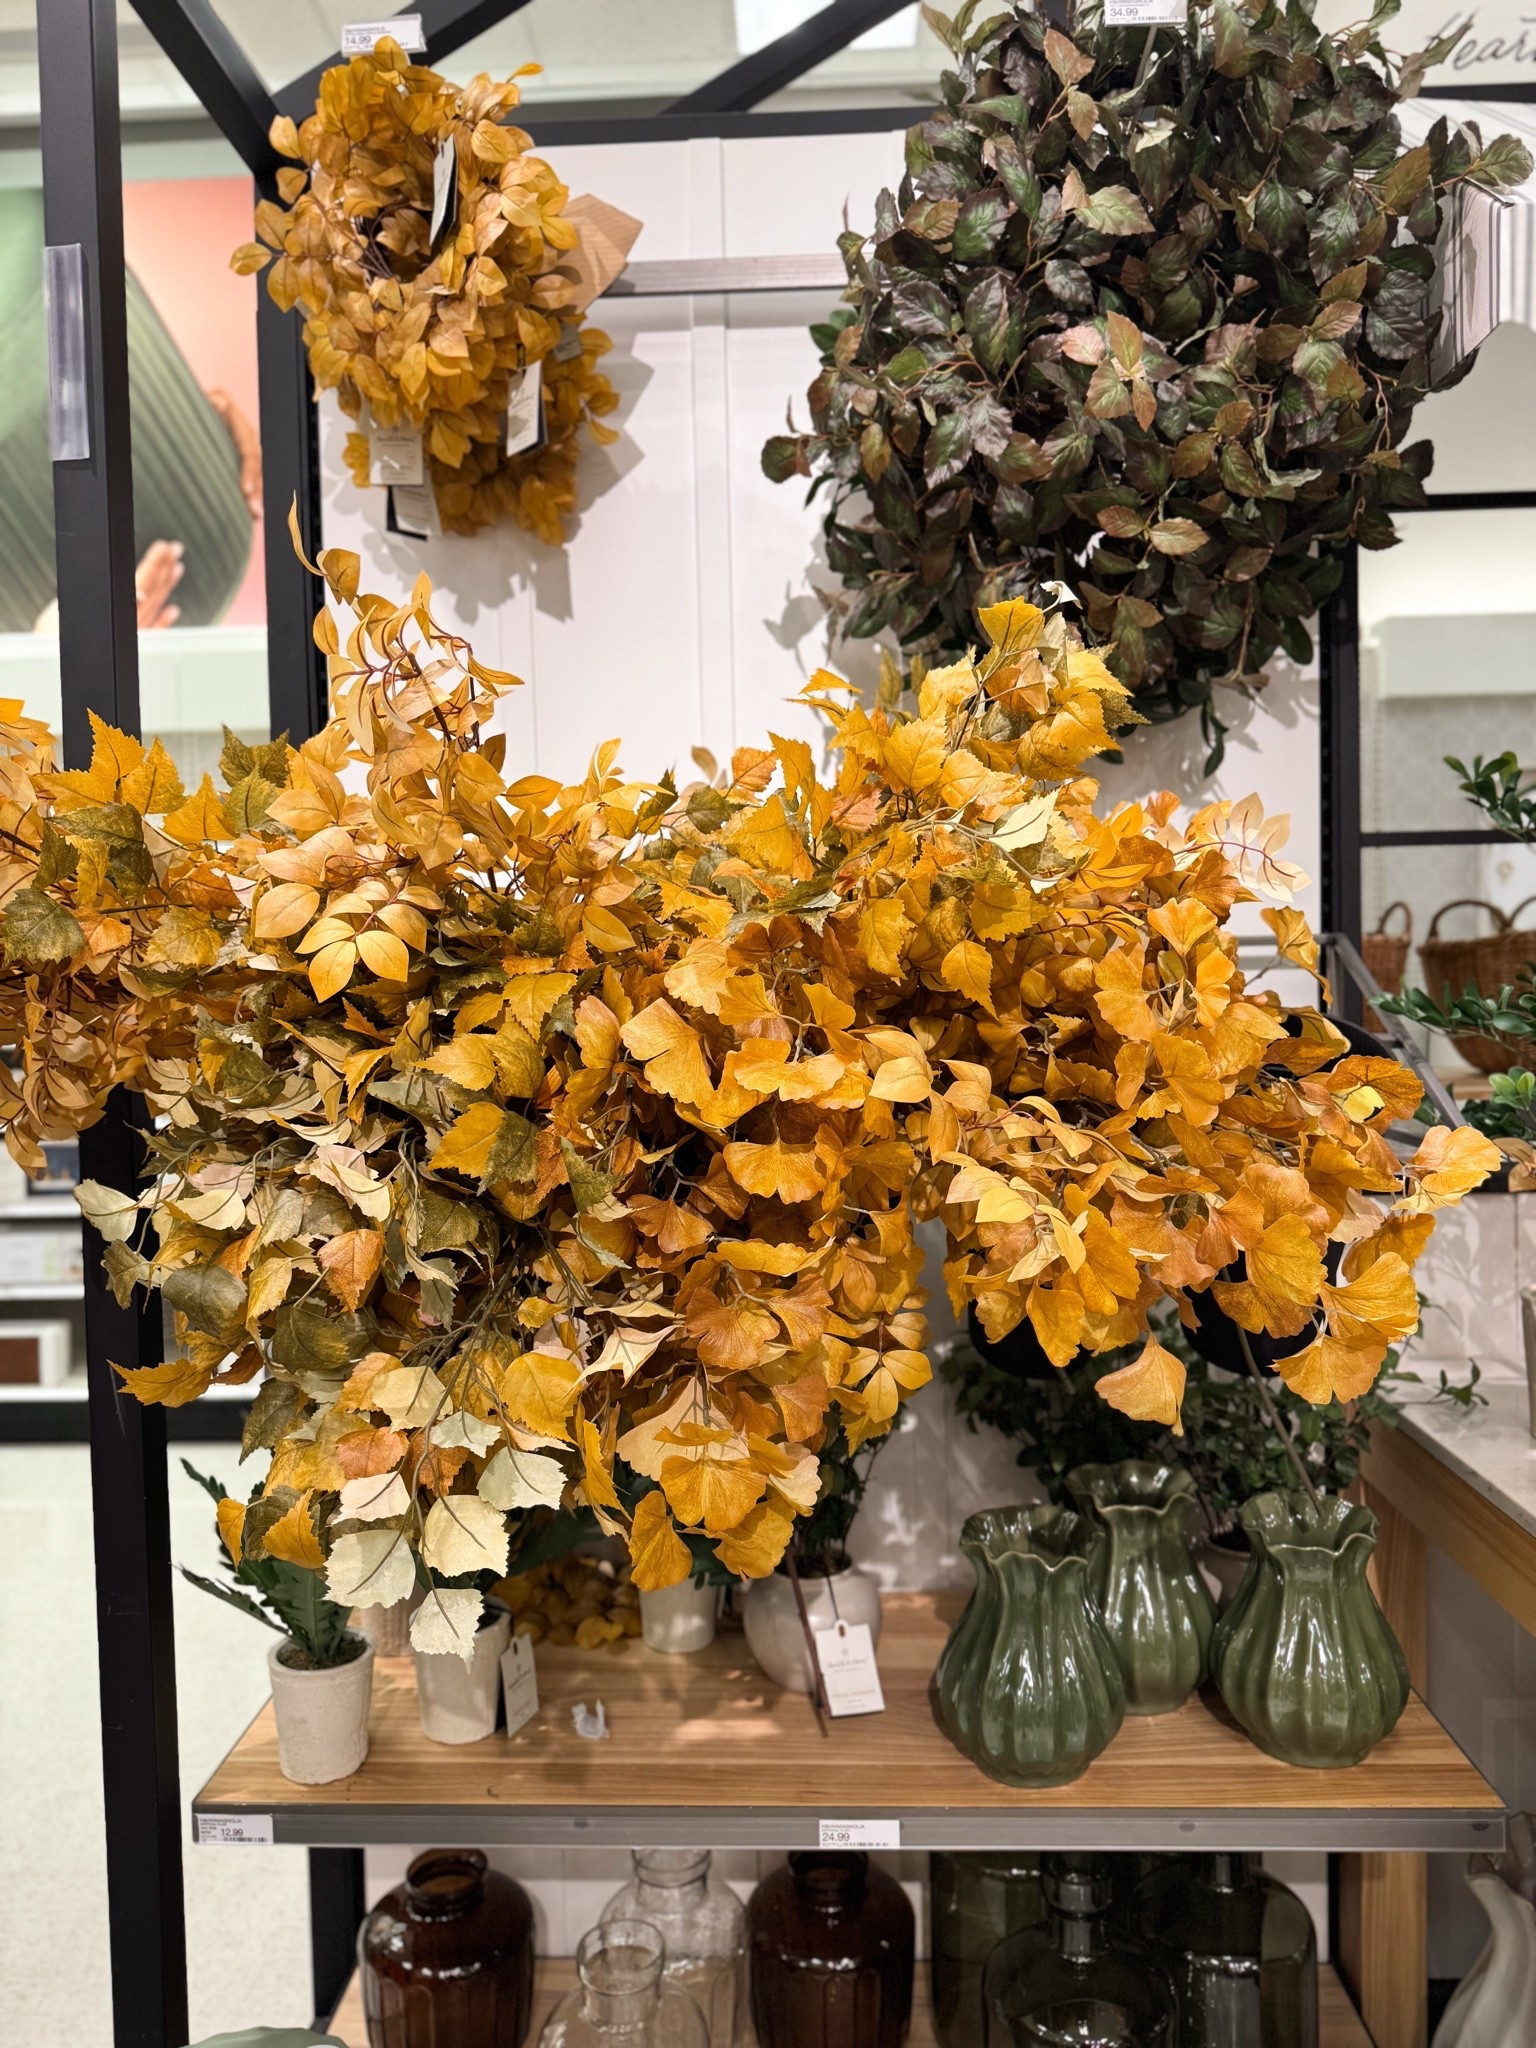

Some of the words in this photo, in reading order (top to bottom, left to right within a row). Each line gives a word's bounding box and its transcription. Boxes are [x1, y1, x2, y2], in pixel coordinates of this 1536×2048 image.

[1110, 7, 1139, 17] 34.99
[345, 35, 371, 45] 14.99
[220, 1828, 244, 1837] 12.99
[822, 1832, 850, 1842] 24.99
